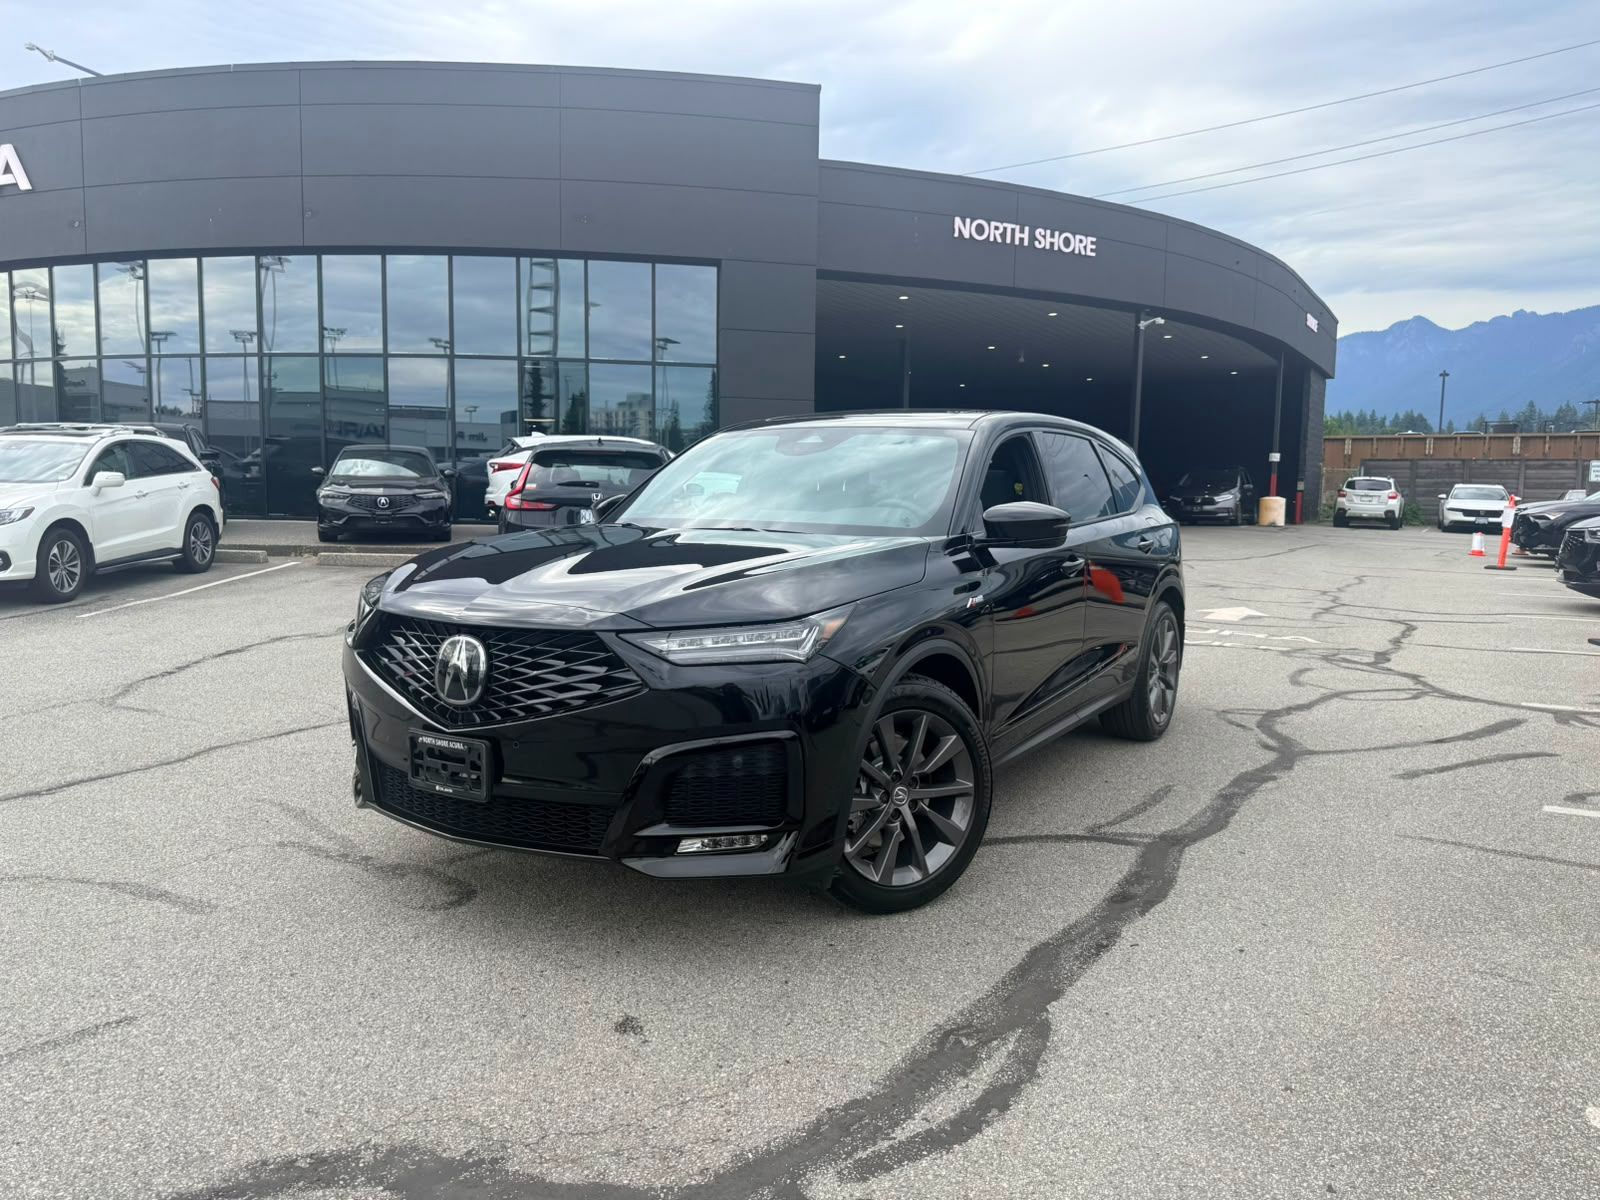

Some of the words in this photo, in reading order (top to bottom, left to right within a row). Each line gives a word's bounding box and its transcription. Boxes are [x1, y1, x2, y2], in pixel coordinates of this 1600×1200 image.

[953, 216, 1029, 247] NORTH
[1034, 227, 1097, 257] SHORE
[422, 736, 435, 745] NORTH
[435, 739, 449, 748] SHORE
[449, 741, 464, 750] ACURA
